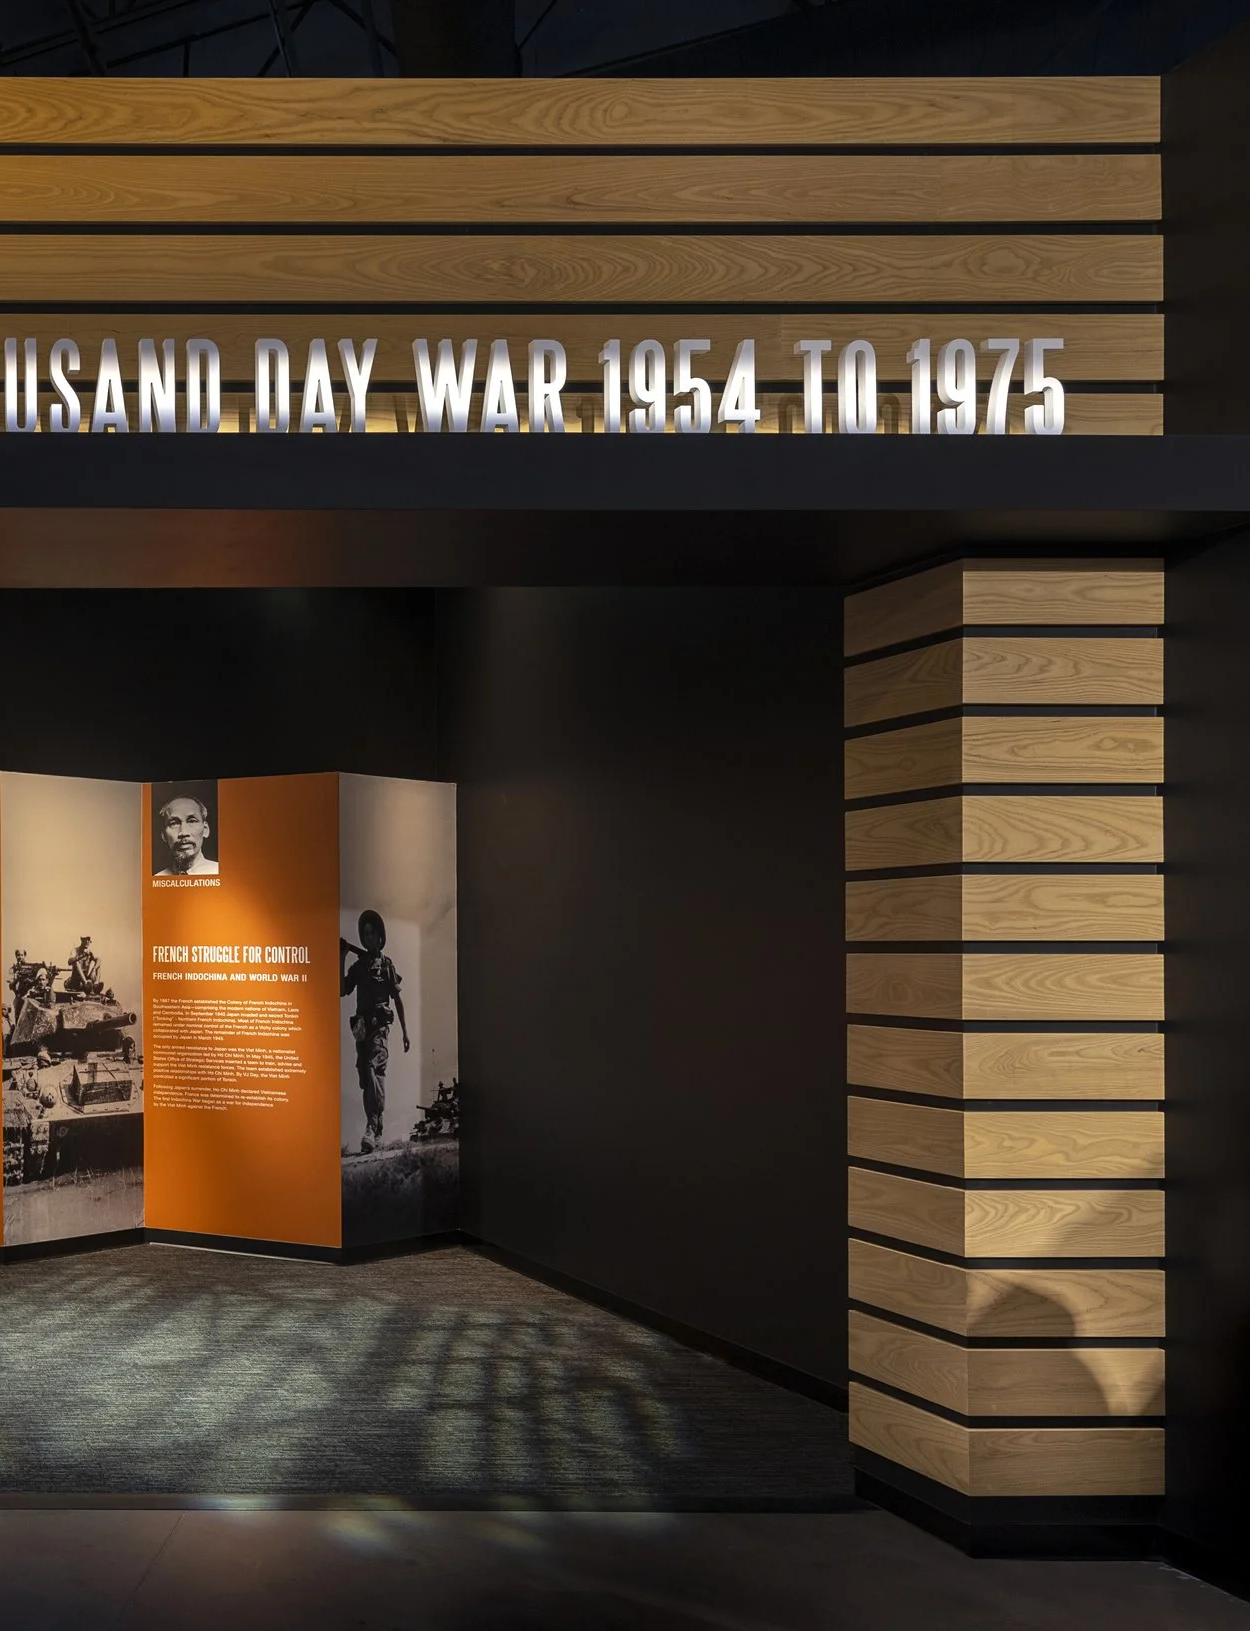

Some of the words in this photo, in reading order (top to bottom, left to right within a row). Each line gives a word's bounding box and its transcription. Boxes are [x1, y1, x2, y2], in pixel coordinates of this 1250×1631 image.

[255, 338, 378, 433] DAY
[413, 338, 568, 433] WAR
[598, 338, 760, 433] 1954
[794, 340, 876, 434] TO
[906, 338, 1065, 435] 1975
[152, 878, 221, 888] MISCALCULATIONS
[152, 946, 189, 963] FRENCH
[191, 946, 240, 964] STRUGGLE
[242, 946, 262, 964] FOR
[264, 946, 311, 964] CONTROL
[152, 972, 183, 981] FRENCH
[184, 973, 227, 982] INDOCHINA
[229, 973, 247, 982] AND
[248, 973, 278, 982] WORLD
[280, 974, 299, 982] WAR
[301, 974, 308, 982] II
[259, 1024, 271, 1032] Vichy
